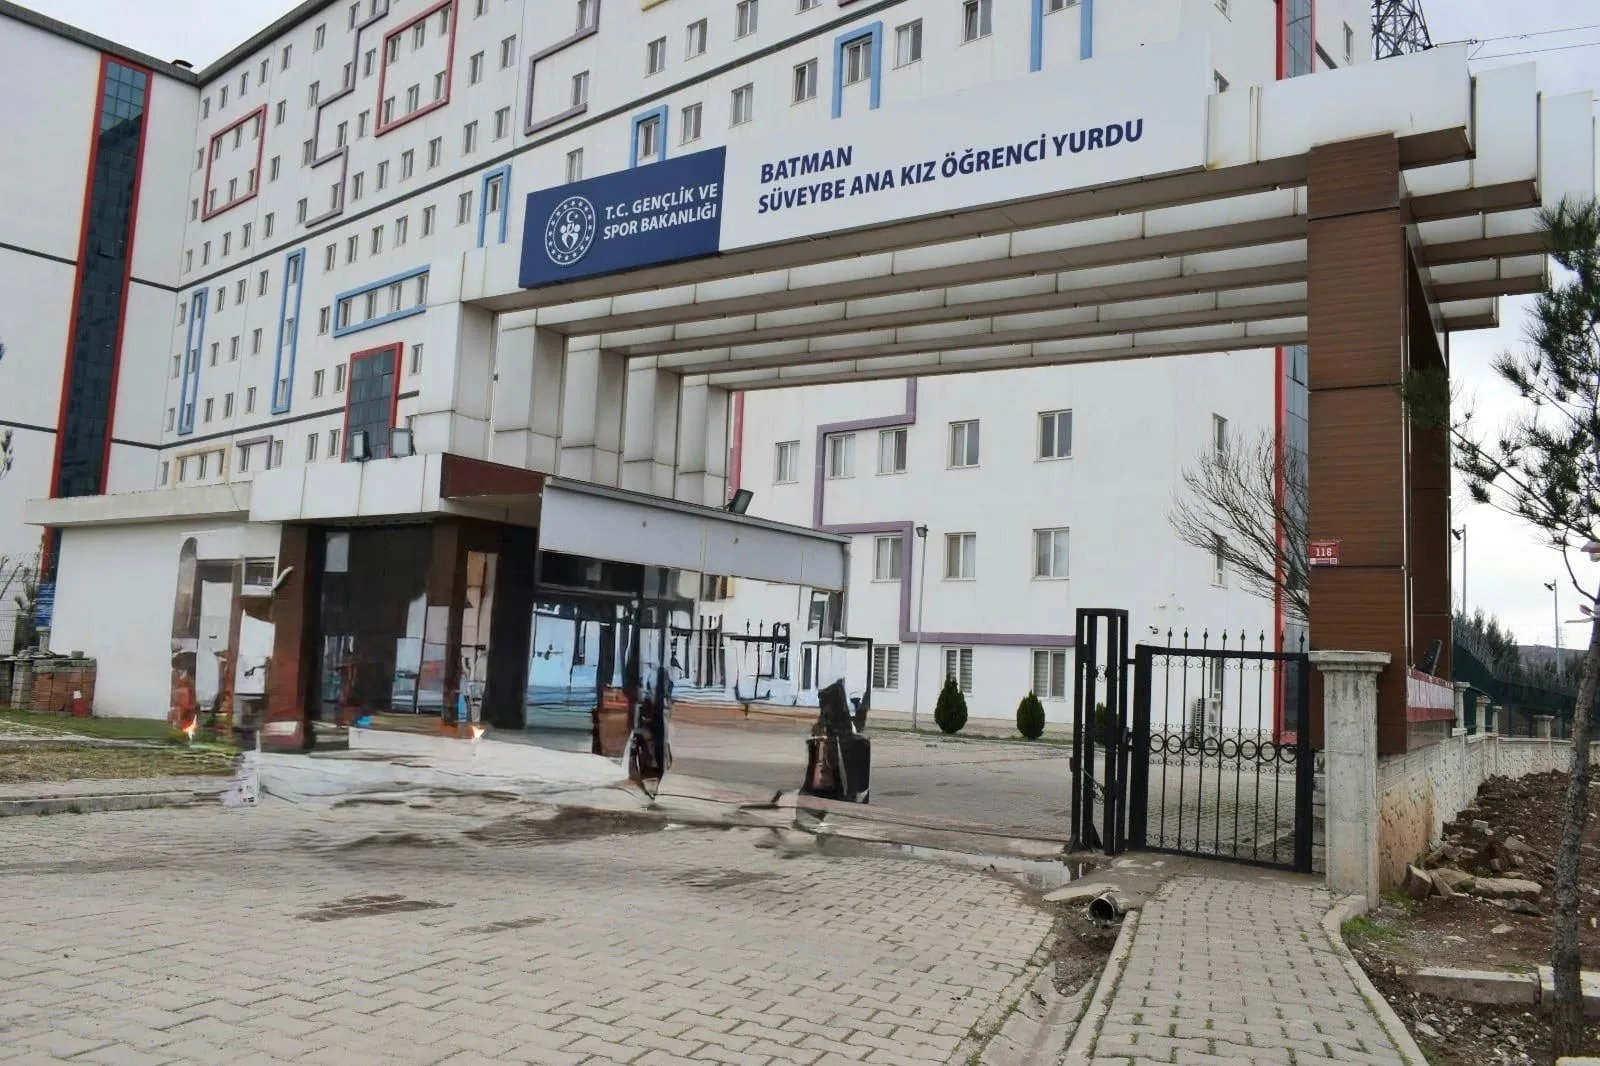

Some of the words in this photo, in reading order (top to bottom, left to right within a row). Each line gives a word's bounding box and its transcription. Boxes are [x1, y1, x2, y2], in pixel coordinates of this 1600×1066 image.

[758, 180, 845, 214] SÜVEYBE
[850, 170, 894, 196] ANA
[901, 161, 936, 186] KIZ
[941, 133, 1046, 178] ÖĞRENCİ
[1052, 118, 1143, 157] YURDU
[760, 146, 852, 184] BATMAN
[605, 204, 628, 220] T.C.
[632, 186, 694, 214] GENÇLİK
[699, 183, 718, 200] VE
[603, 222, 637, 240] SPOR
[640, 204, 717, 231] BAKANLIĞI
